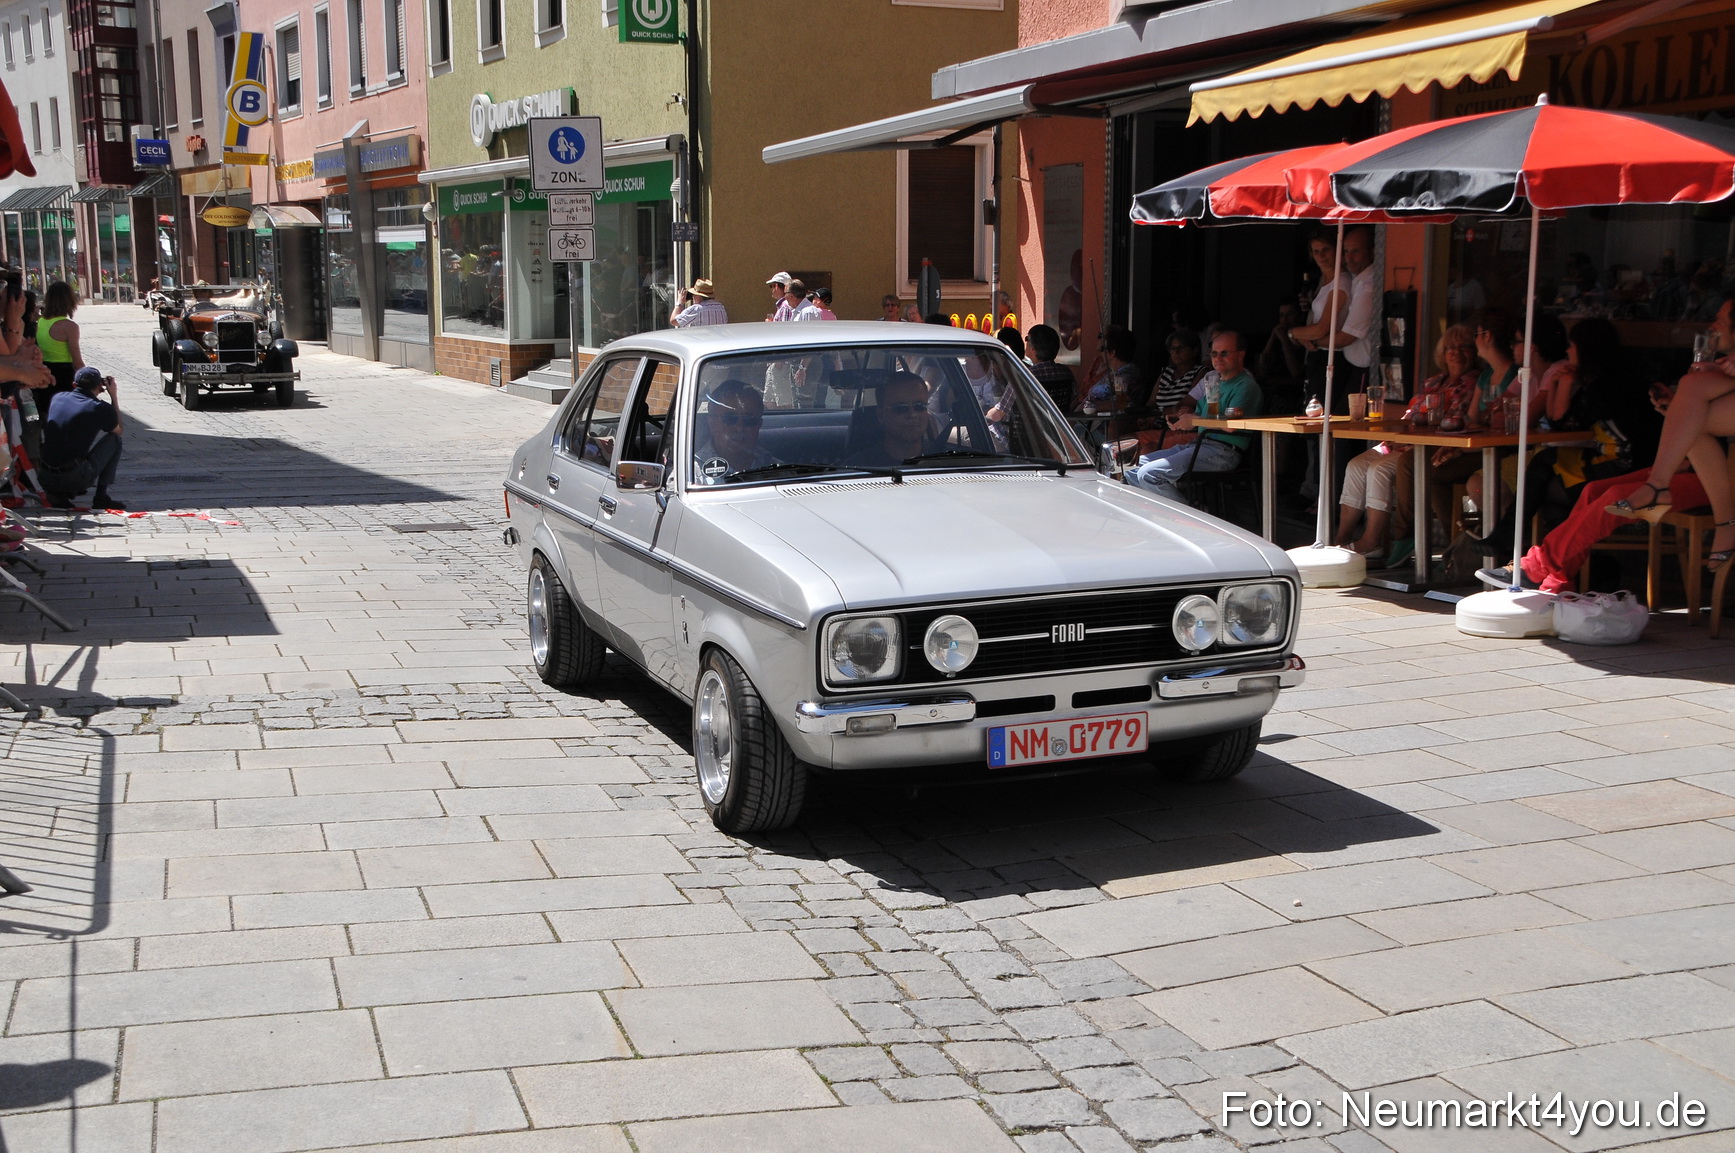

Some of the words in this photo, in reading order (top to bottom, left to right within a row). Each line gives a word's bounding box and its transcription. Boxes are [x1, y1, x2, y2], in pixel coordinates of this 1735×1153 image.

[1547, 27, 1735, 109] KOLLE
[239, 90, 261, 113] B
[488, 98, 521, 133] QUICK
[522, 89, 562, 123] SCHUH
[140, 146, 167, 155] CECIL
[605, 179, 623, 194] QUICK
[624, 177, 645, 192] SCHUH
[460, 193, 473, 206] QUICK
[473, 191, 488, 204] SCHUH
[528, 191, 548, 200] QUIC
[565, 249, 580, 258] frei
[212, 364, 222, 372] 28
[1052, 622, 1085, 644] FORD
[993, 751, 1001, 760] D
[1010, 726, 1049, 761] NM
[1069, 718, 1142, 755] 0779
